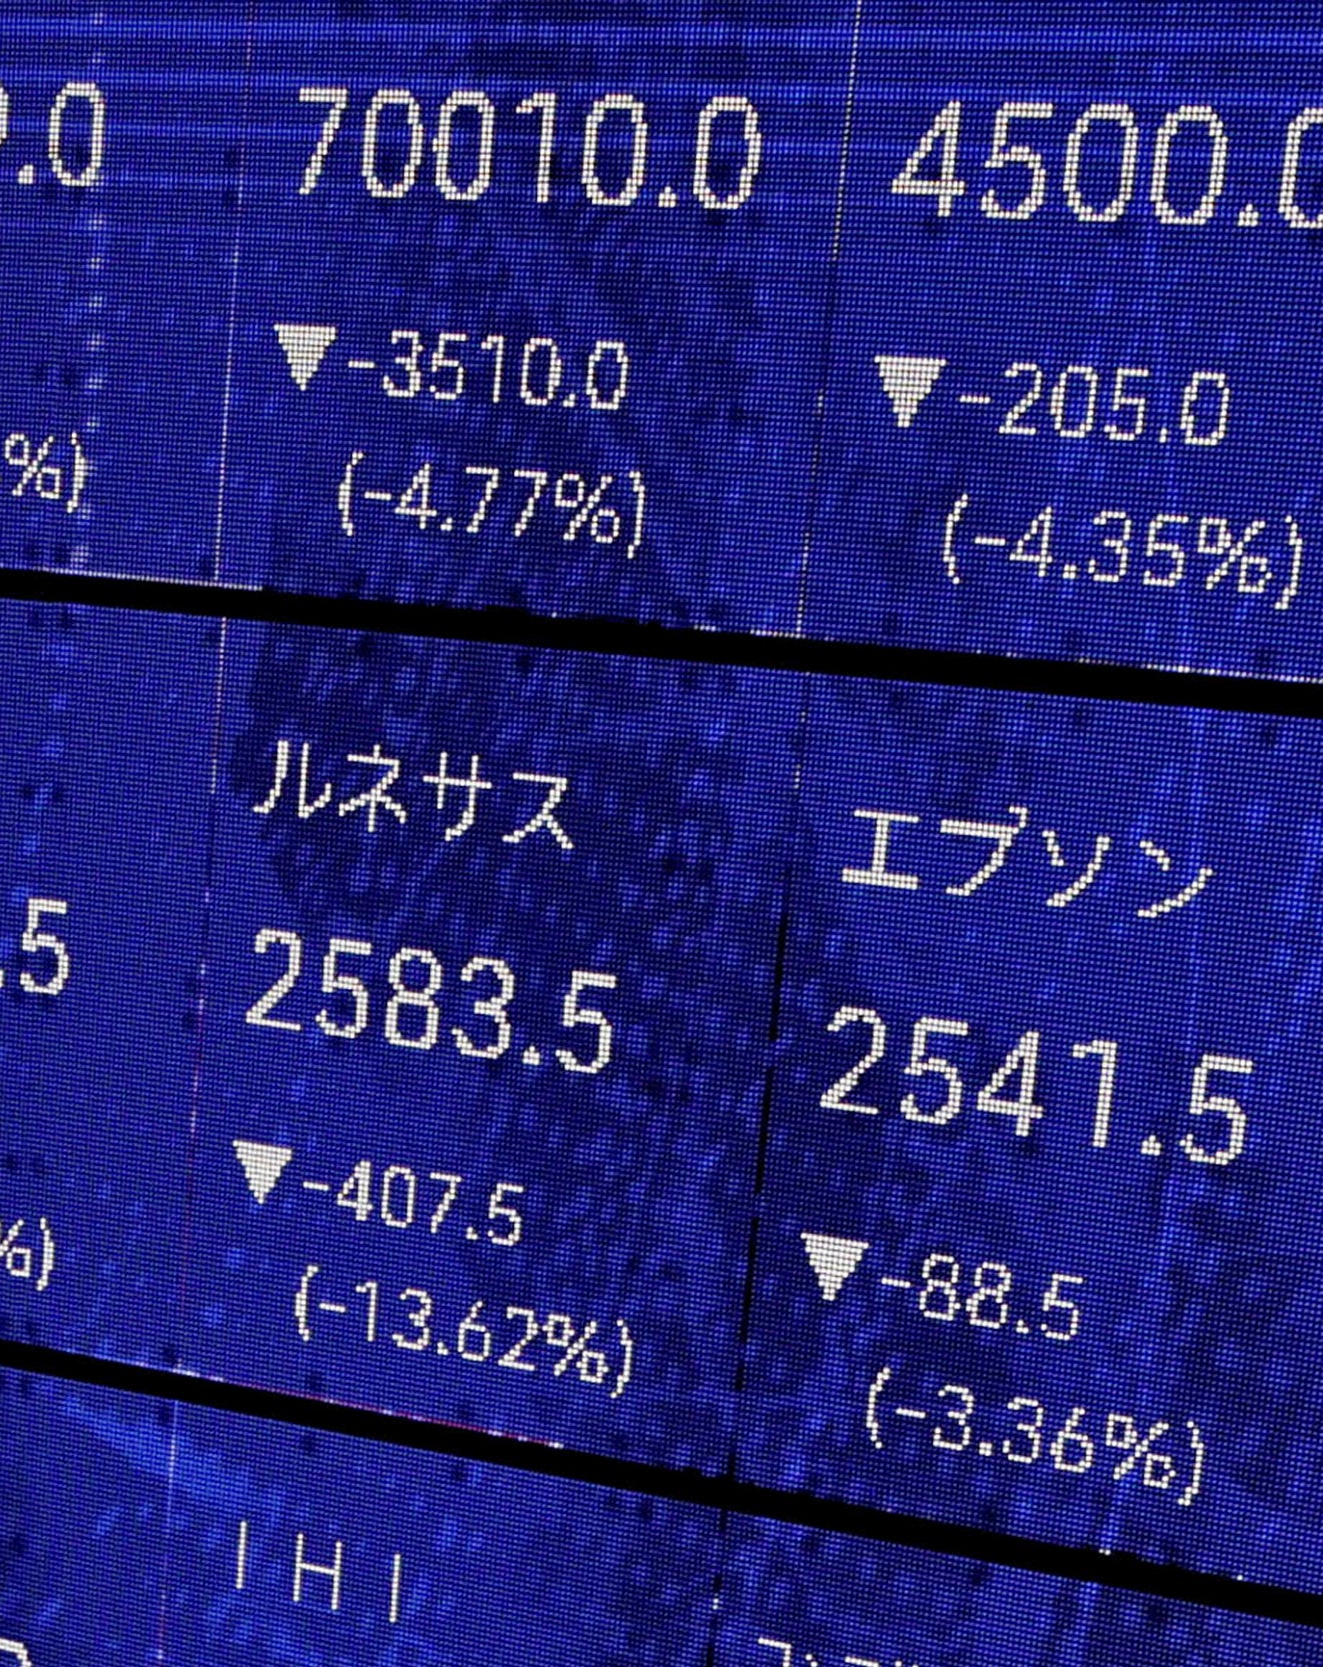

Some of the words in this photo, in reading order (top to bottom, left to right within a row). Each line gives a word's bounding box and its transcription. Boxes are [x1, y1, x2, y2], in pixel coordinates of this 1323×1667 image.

[298, 86, 763, 211] 70010.0
[942, 493, 1304, 611] (-4.35%)
[252, 739, 574, 852] ルネサス
[840, 805, 1214, 919] エプソン
[244, 927, 618, 1075] 2583.5
[819, 1005, 1254, 1166] 2541.5
[880, 1252, 1084, 1342] -88.5
